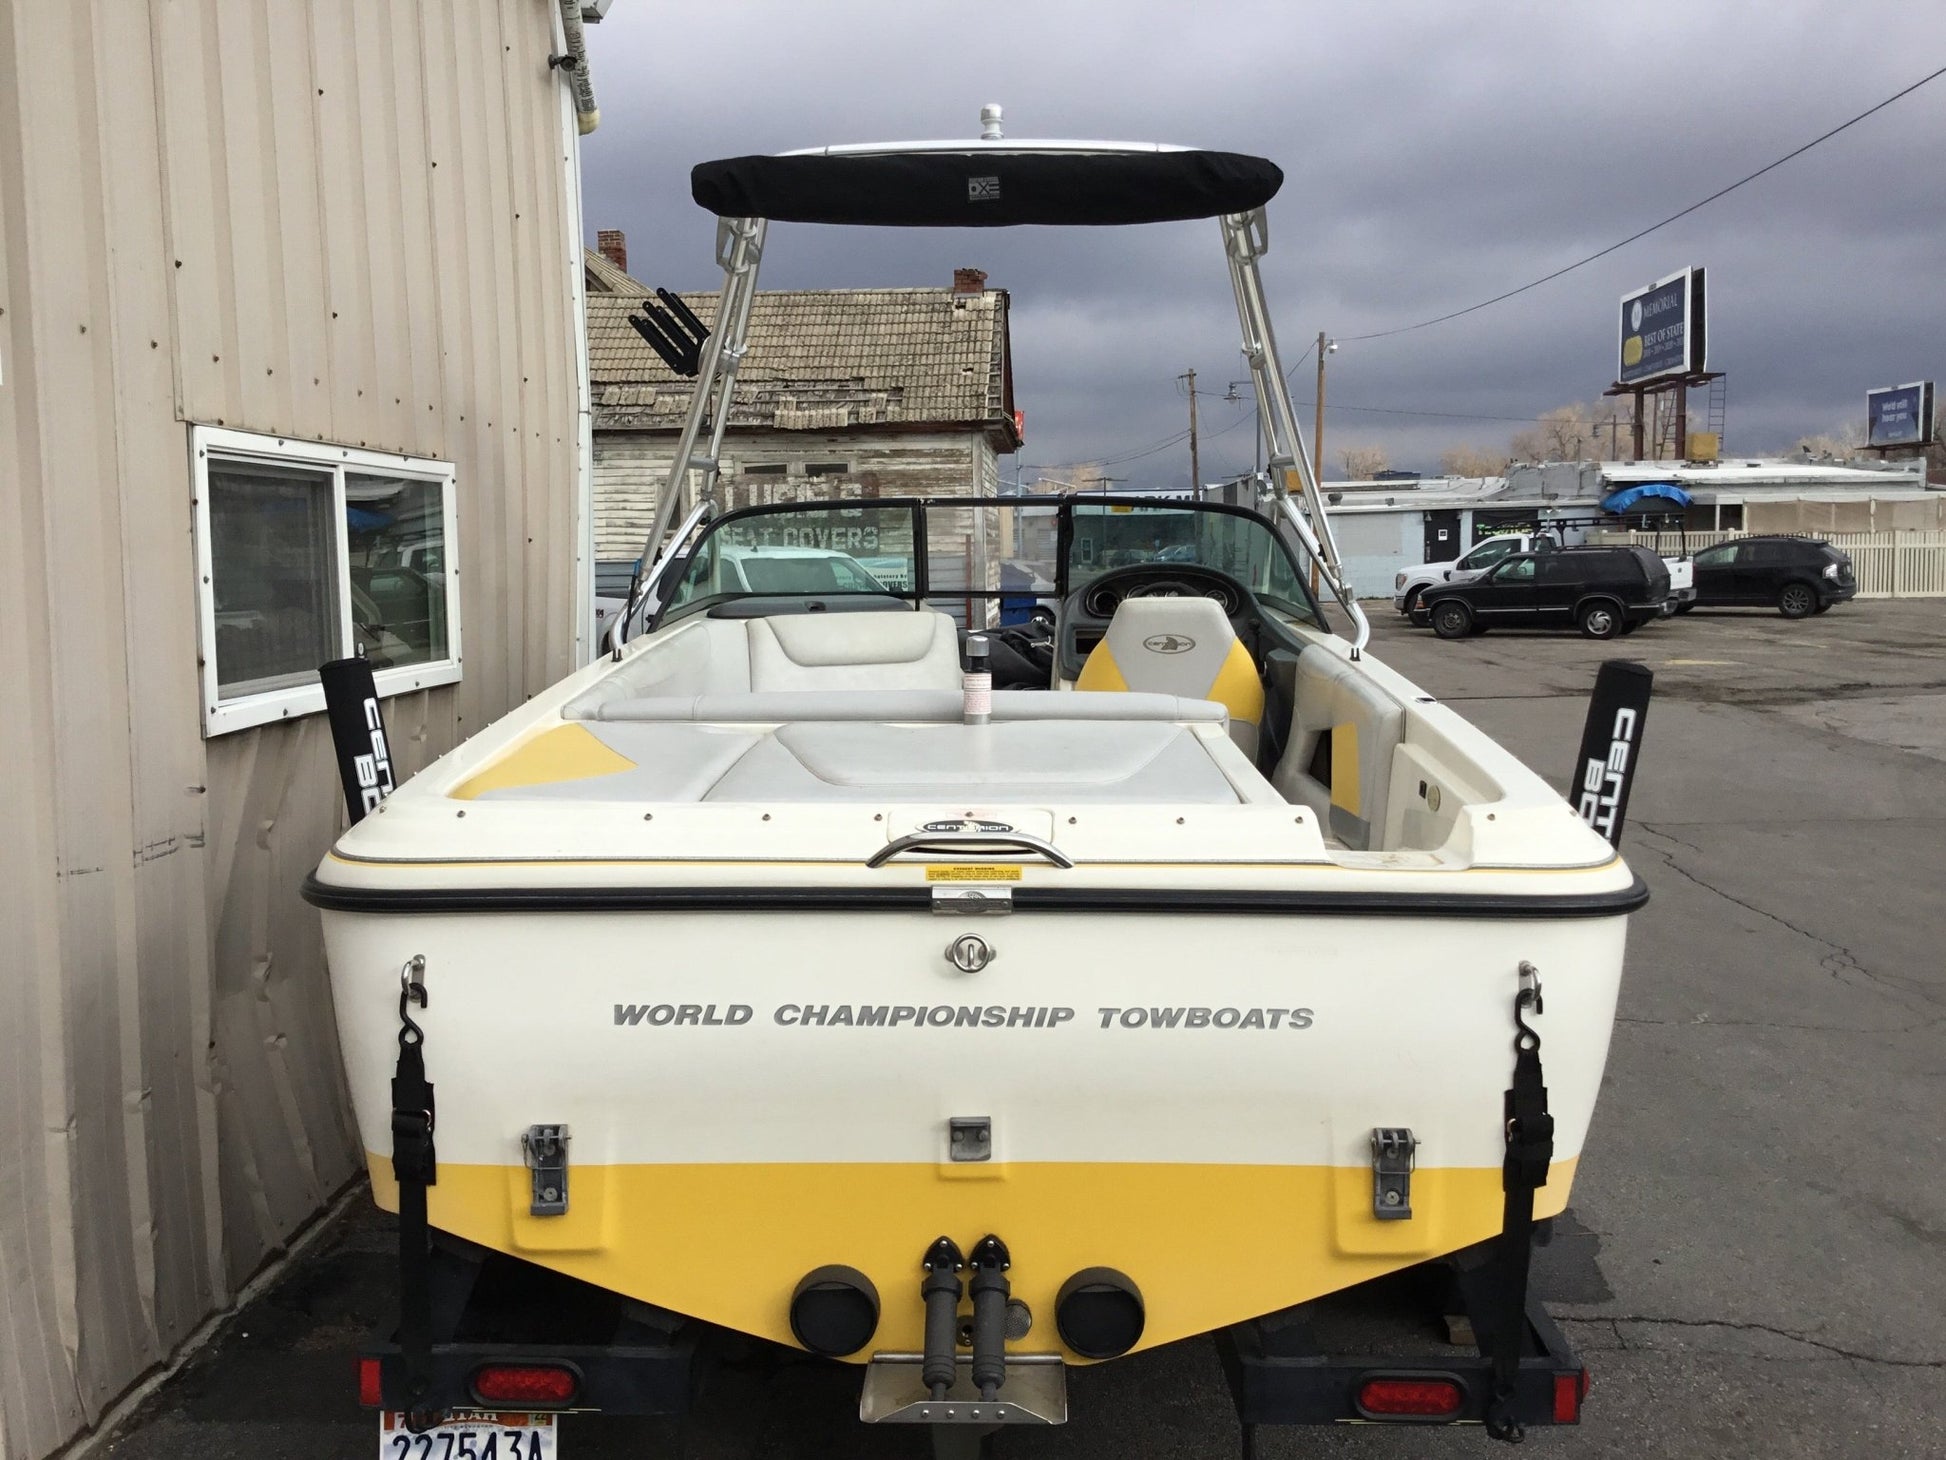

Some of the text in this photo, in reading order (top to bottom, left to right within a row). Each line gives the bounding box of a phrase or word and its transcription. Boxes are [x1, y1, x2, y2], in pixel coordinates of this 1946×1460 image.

[1643, 293, 1678, 319] MEMORIAL
[1667, 320, 1684, 338] STATE
[783, 526, 879, 551] COVERS
[1594, 707, 1637, 840] CENT
[613, 1004, 1315, 1030] WORLD CHAMPIONSHIP TOWBOATS
